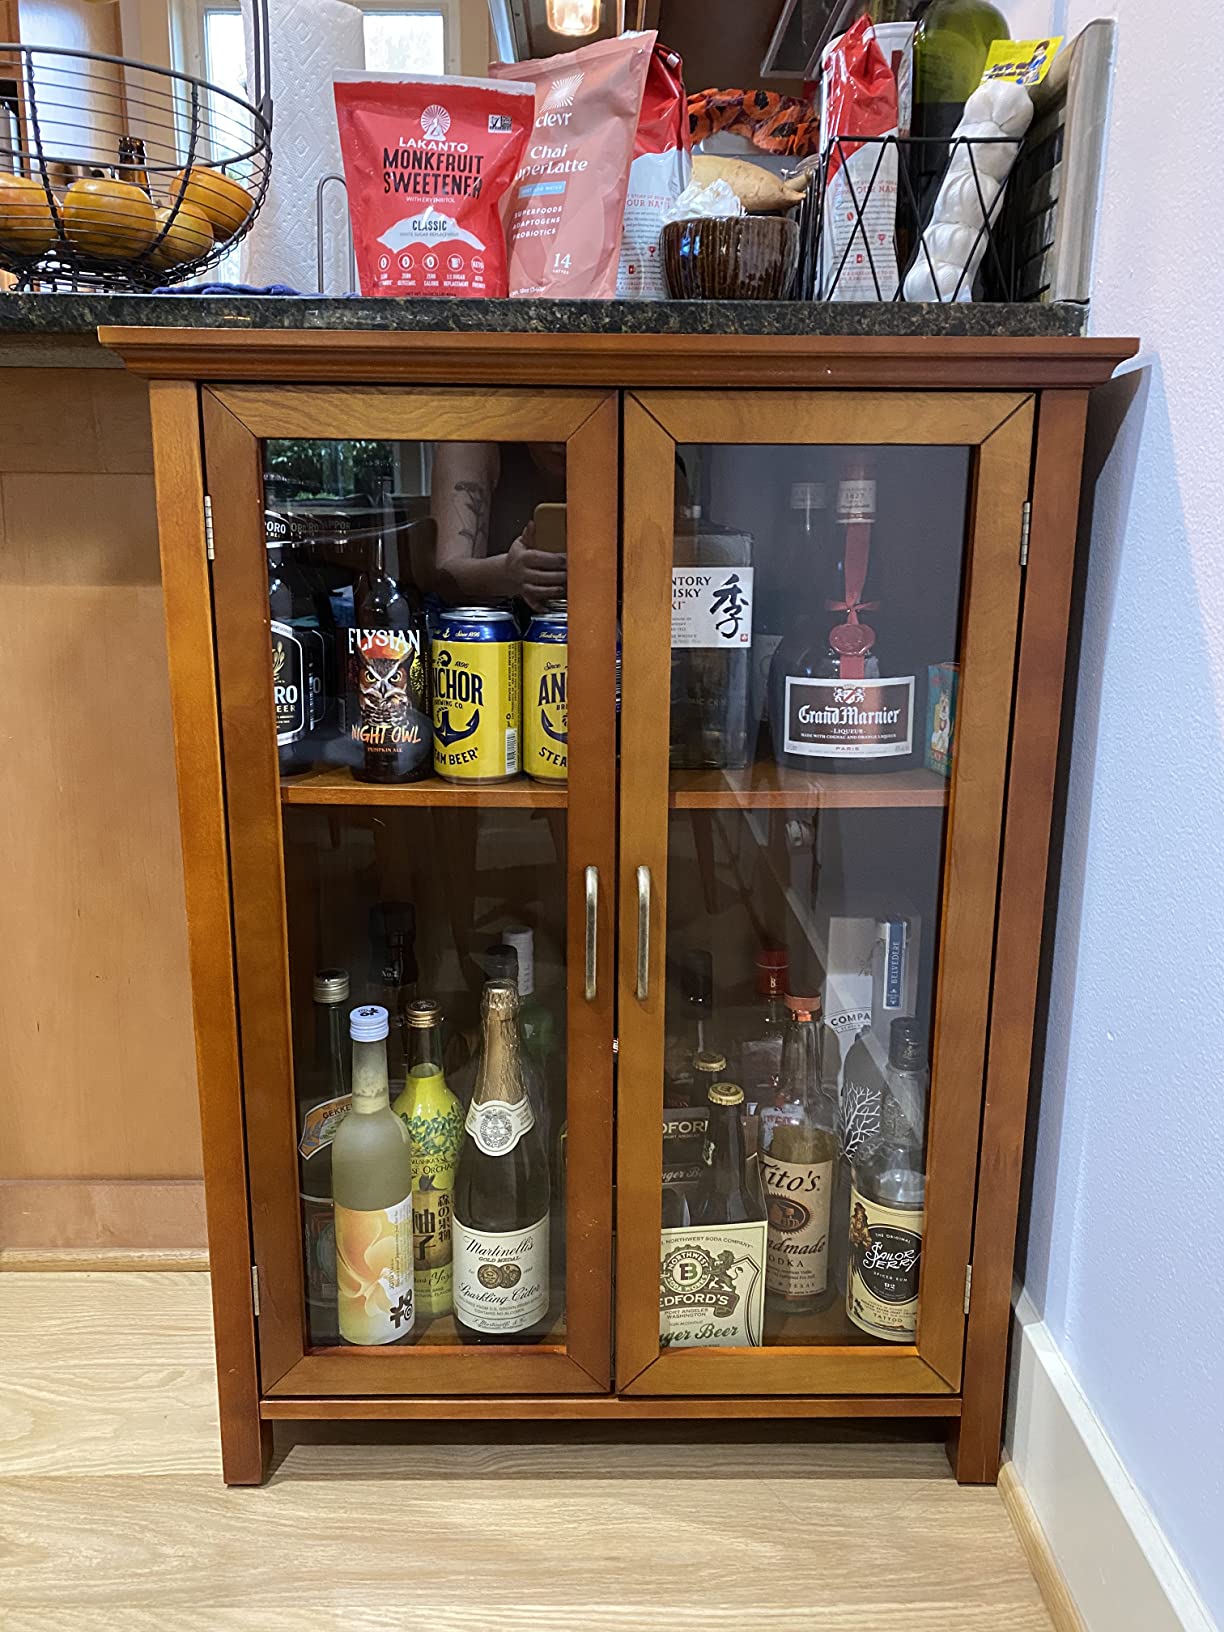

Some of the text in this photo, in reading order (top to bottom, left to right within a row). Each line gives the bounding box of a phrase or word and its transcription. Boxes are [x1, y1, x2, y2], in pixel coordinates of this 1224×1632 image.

[536, 112, 572, 128] clevr
[399, 137, 468, 152] LAKANTO
[530, 144, 568, 159] Chai
[384, 148, 484, 174] MONKFRUIT
[384, 172, 482, 200] SWEETENER
[514, 206, 562, 218] SUPERFOODS
[412, 220, 447, 231] CLASSIC
[513, 217, 560, 230] ADAPTOGENS
[512, 228, 556, 240] PROBIOTICS
[554, 254, 572, 268] 14
[709, 574, 749, 639] 季
[348, 628, 420, 656] ELYSIAN
[544, 661, 561, 671] Since
[798, 705, 901, 725] Grand Marnier
[352, 724, 421, 744] NIGHT OWL
[449, 750, 478, 765] BEER
[538, 747, 567, 767] STEA
[890, 941, 900, 984] BELVEDERE
[831, 1012, 871, 1026] COMPA
[438, 1194, 450, 1242] 森の果物
[464, 1235, 534, 1257] Martinelli's
[723, 1238, 753, 1248] COMPANY
[865, 1242, 914, 1260] SAILOR
[668, 1252, 708, 1270] NORTHWEST
[863, 1254, 921, 1272] JERRY
[679, 1263, 698, 1281] B
[667, 1274, 708, 1291] SODA WORKS
[458, 1282, 509, 1306] Sparkling
[512, 1284, 540, 1302] Cider
[873, 1313, 903, 1322] TATTOO
[695, 1323, 739, 1340] Beer
